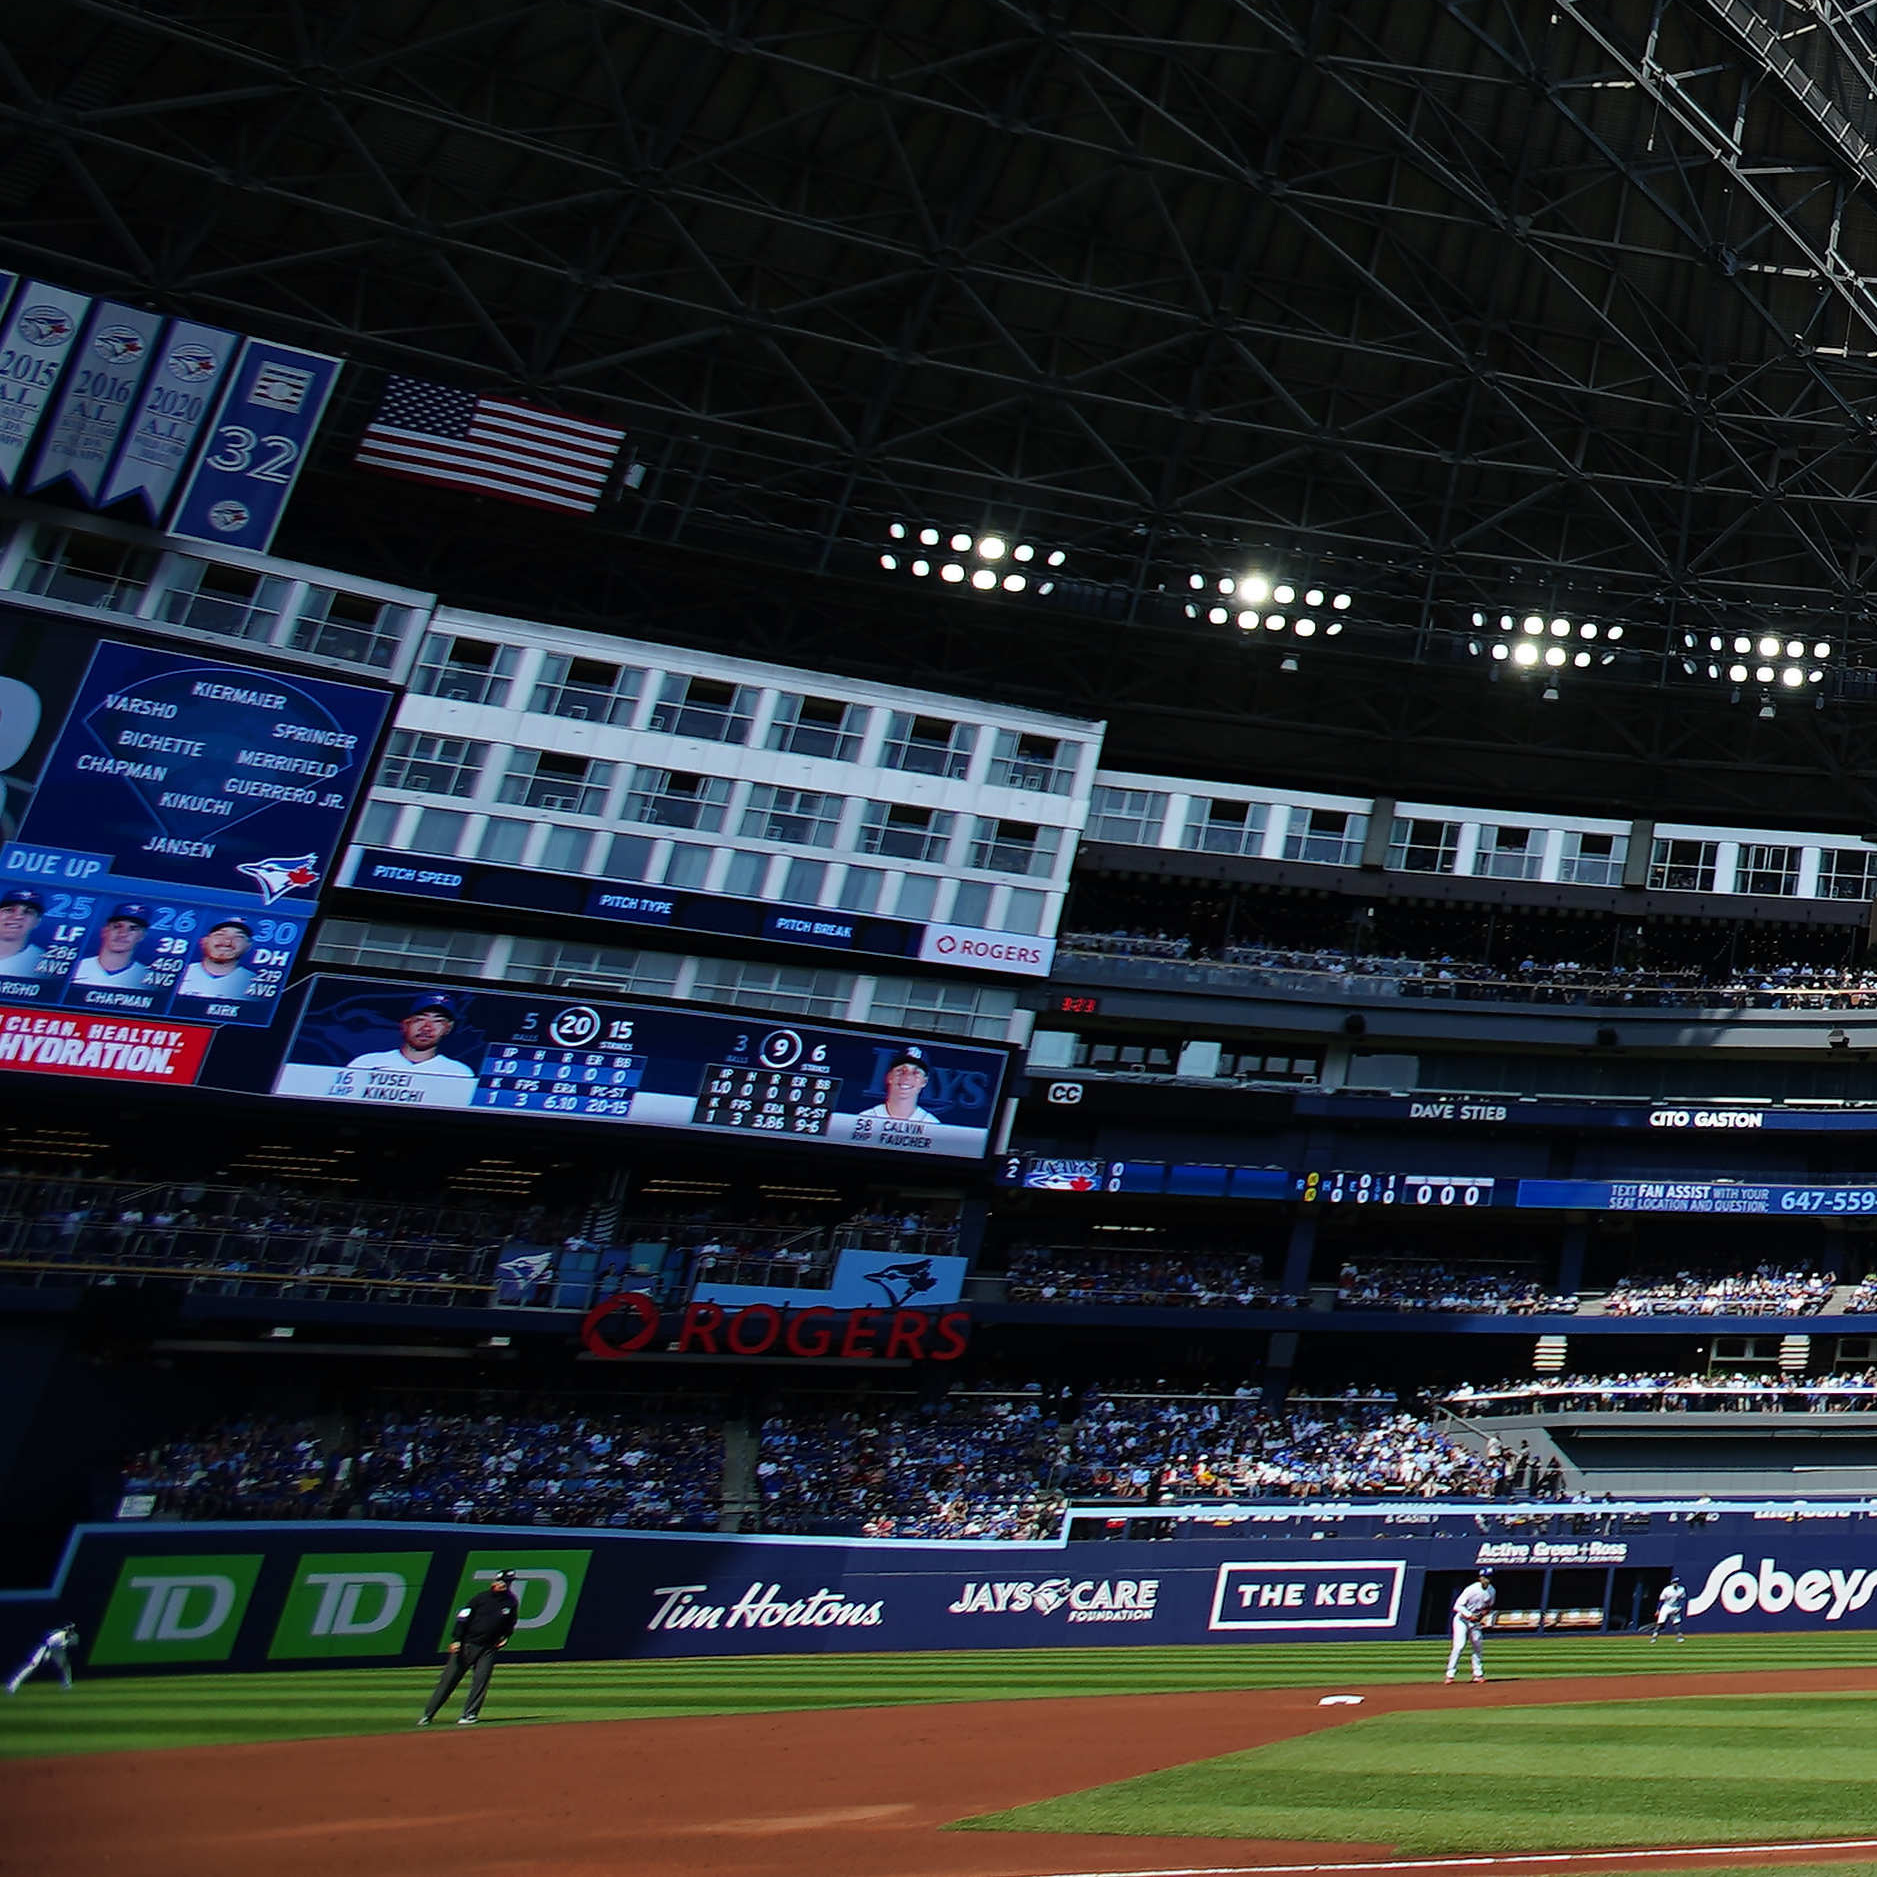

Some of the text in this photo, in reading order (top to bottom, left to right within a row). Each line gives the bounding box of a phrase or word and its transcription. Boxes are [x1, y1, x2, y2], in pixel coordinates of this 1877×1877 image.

[1, 350, 59, 386] 2015
[73, 370, 136, 403] 2016
[147, 386, 203, 421] 2020
[206, 425, 298, 484] 32
[103, 694, 178, 719] VARSHO
[191, 681, 287, 710] KIERMAIER
[117, 730, 206, 757] BICHETTE
[272, 723, 358, 750] SPRINGER
[76, 754, 168, 782] CHAPMAN
[237, 749, 339, 778] MERRIFIELD
[160, 792, 233, 815] KIKUCHI
[224, 778, 317, 805] GUERRERO
[142, 836, 216, 858] JANSEN
[7, 851, 101, 879] DUE UP
[372, 864, 463, 888] PITCH SPEED
[45, 894, 96, 920] 25
[599, 893, 674, 915] PITCH TYPE
[151, 907, 197, 933] 26
[252, 920, 299, 945] 30
[54, 925, 86, 942] LF
[156, 937, 188, 955] 3B
[252, 949, 290, 967] DH
[960, 940, 1042, 965] ROGERS
[142, 972, 175, 987] AVG
[85, 991, 153, 1009] CHAPMAN
[5, 1015, 185, 1048] CLEAN. HEALTHY.
[560, 1016, 592, 1035] 20
[608, 1021, 634, 1040] 15
[0, 1032, 175, 1074] HYDRATION.
[336, 1071, 414, 1088] 16 YUSEI
[362, 1087, 424, 1104] KIKUCHI
[1052, 1084, 1081, 1103] CC
[1409, 1103, 1507, 1121] DAVE STIEB
[1650, 1111, 1763, 1129] CITO GASTON
[1636, 1198, 1689, 1212] LOCATION
[1638, 1185, 1666, 1198] FAN
[1666, 1185, 1712, 1199] ASSIST
[1741, 1188, 1769, 1201] YOUR
[678, 1302, 971, 1361] ROGERS
[1478, 1542, 1529, 1556] Active
[305, 1572, 407, 1636] TD
[648, 1584, 725, 1631] Tim
[948, 1579, 1160, 1614] JAYS CARE
[1237, 1582, 1383, 1608] THE KEG
[128, 1575, 238, 1642] TD
[1067, 1609, 1154, 1622] FOUNDATION
